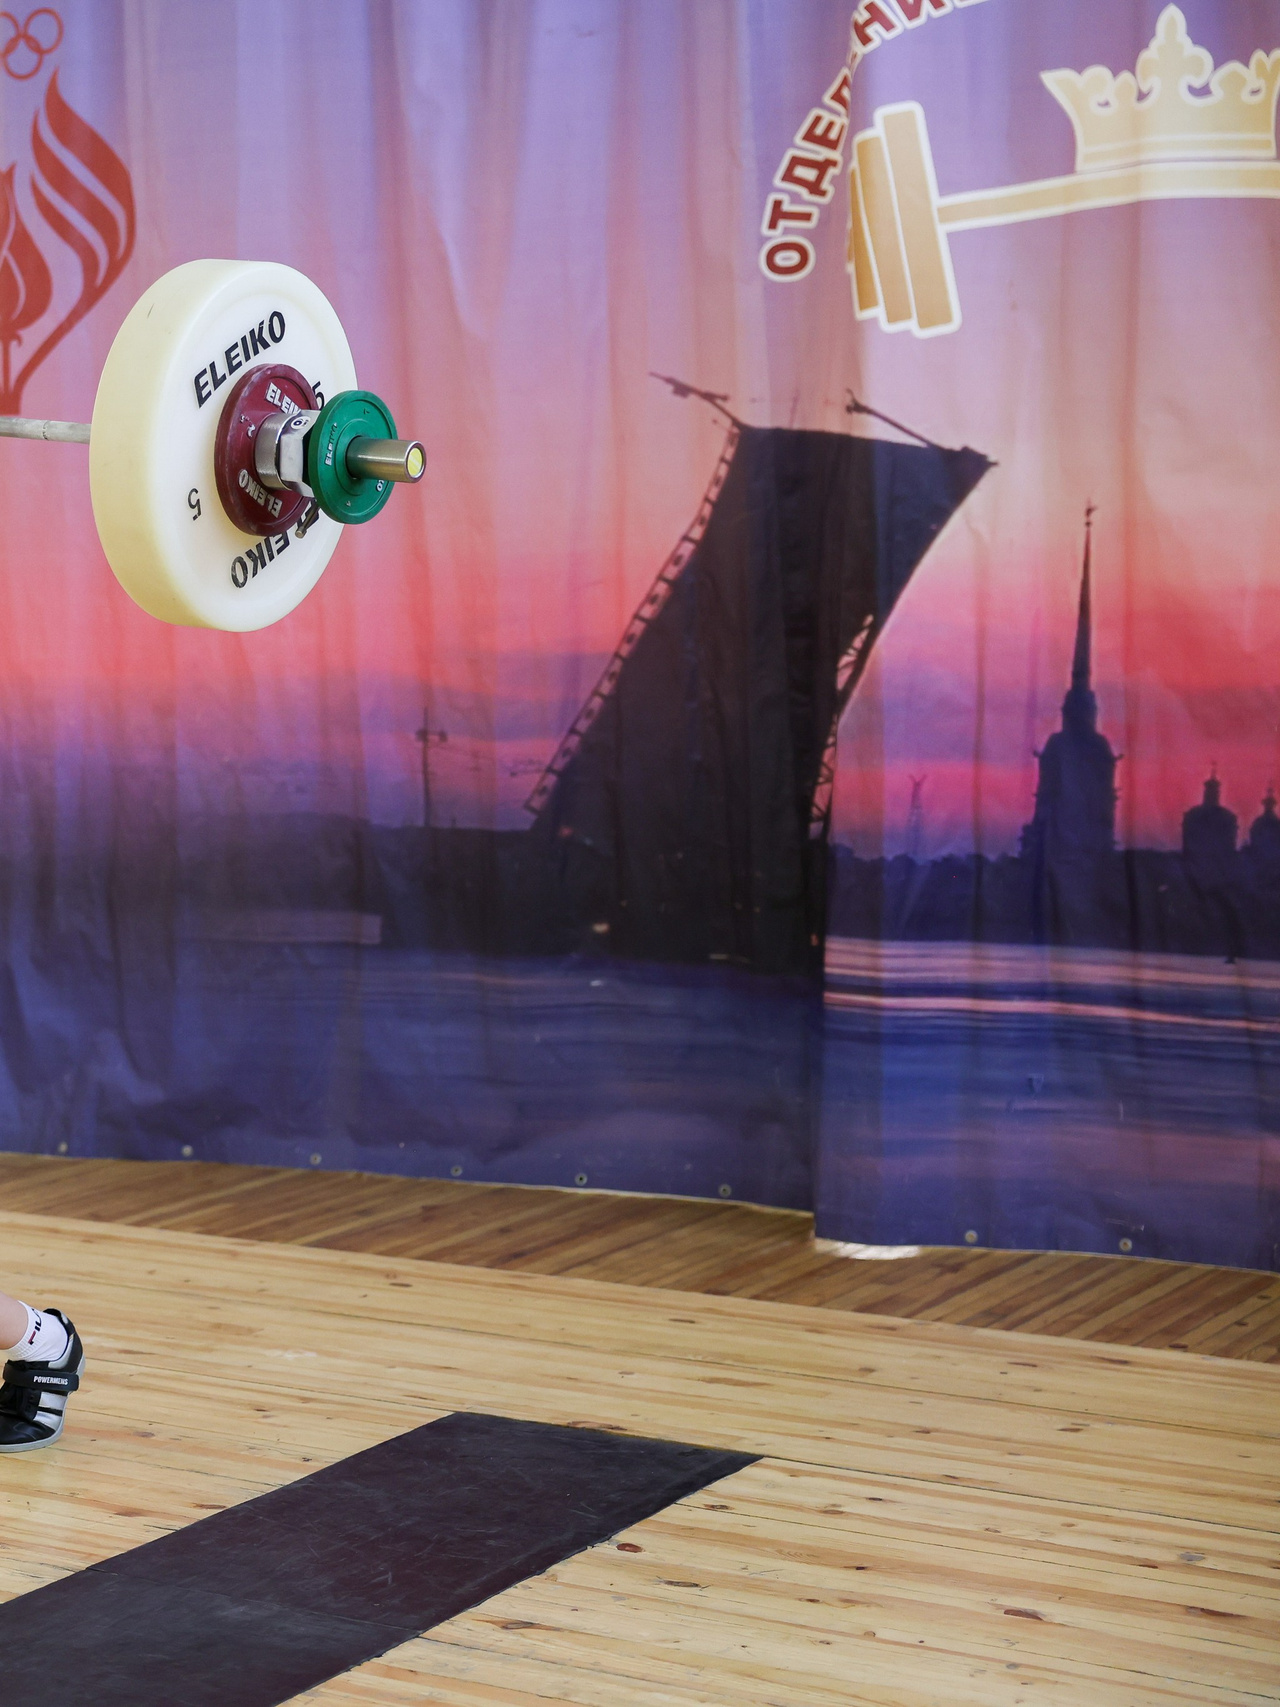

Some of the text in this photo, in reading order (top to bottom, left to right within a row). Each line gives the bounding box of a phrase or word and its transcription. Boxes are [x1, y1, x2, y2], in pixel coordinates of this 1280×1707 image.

[193, 310, 287, 409] ELEIKO
[187, 488, 202, 521] 5
[238, 468, 283, 519] ELEIKO
[231, 499, 320, 589] EEIKO
